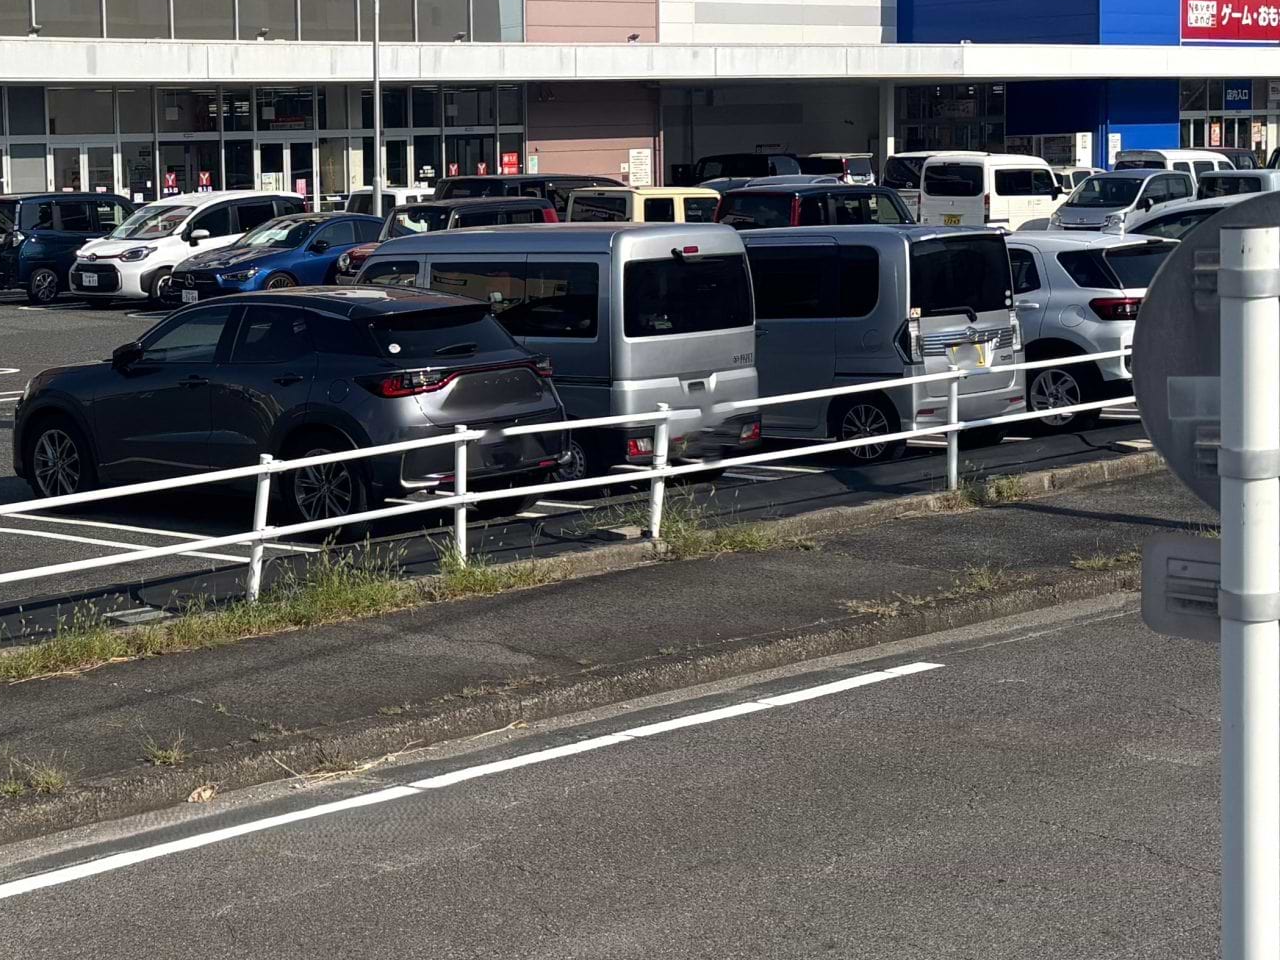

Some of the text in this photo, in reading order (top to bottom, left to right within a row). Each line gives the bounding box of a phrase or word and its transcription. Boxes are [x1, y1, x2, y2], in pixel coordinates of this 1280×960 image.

[1221, 3, 1280, 27] ゲーム・おも
